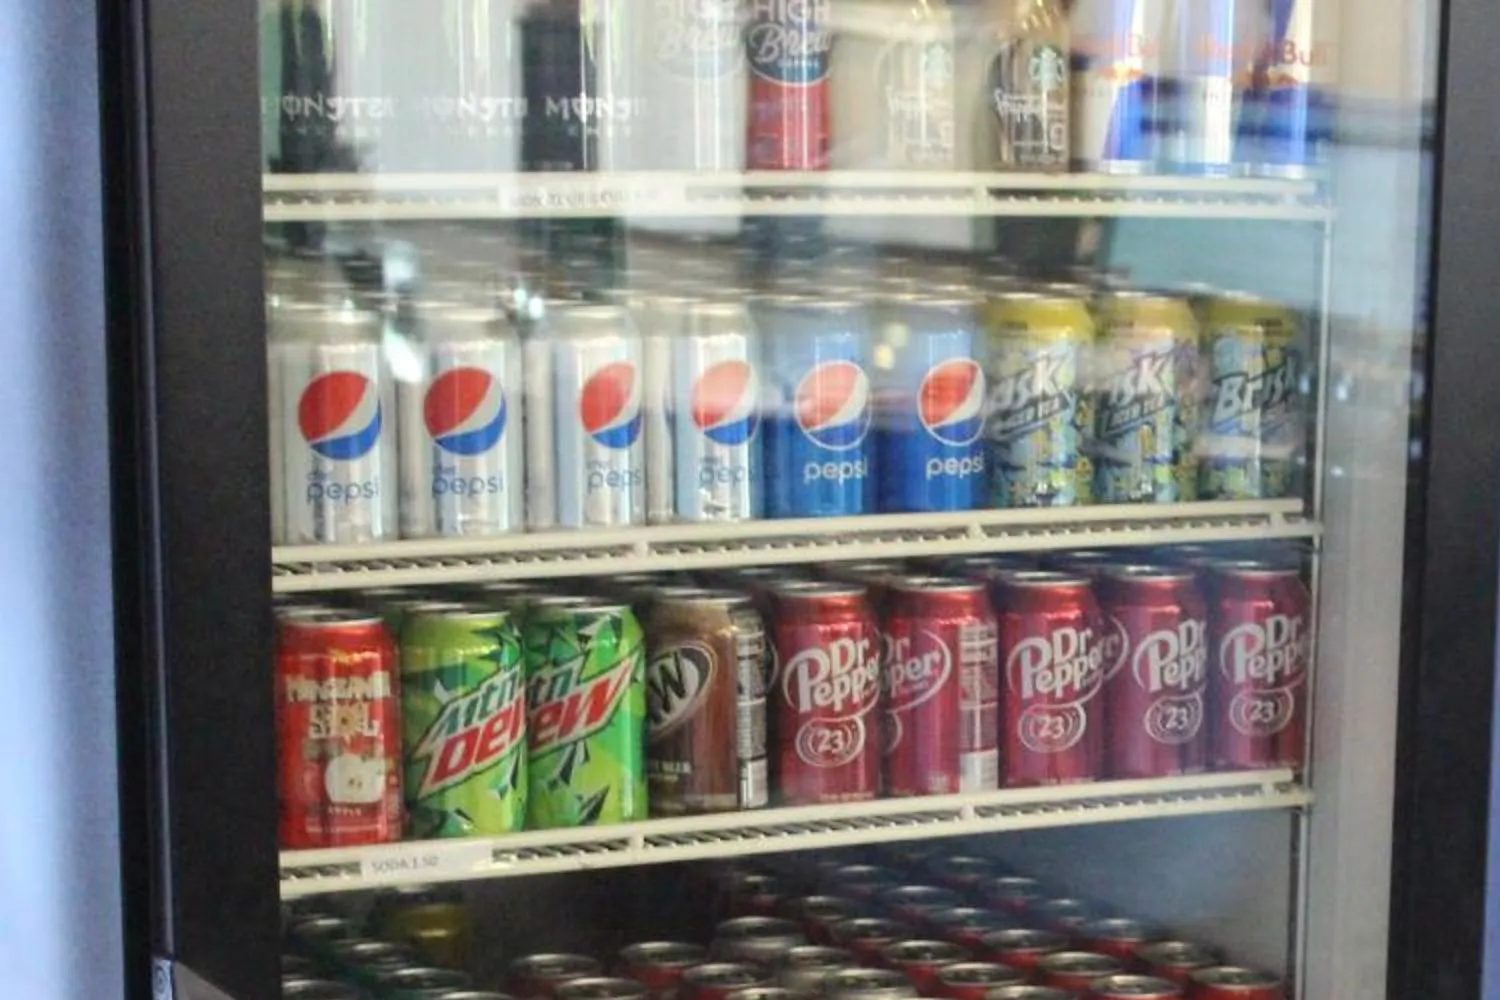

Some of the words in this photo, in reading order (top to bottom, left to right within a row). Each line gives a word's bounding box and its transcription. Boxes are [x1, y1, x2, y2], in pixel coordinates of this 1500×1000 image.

[926, 452, 985, 481] pepsi
[306, 480, 380, 506] pepsi
[829, 636, 870, 673] Dr
[1053, 626, 1093, 660] Dr
[1165, 709, 1188, 729] 23
[1251, 701, 1276, 721] 23
[1039, 717, 1064, 737] 23
[814, 732, 845, 751] 23
